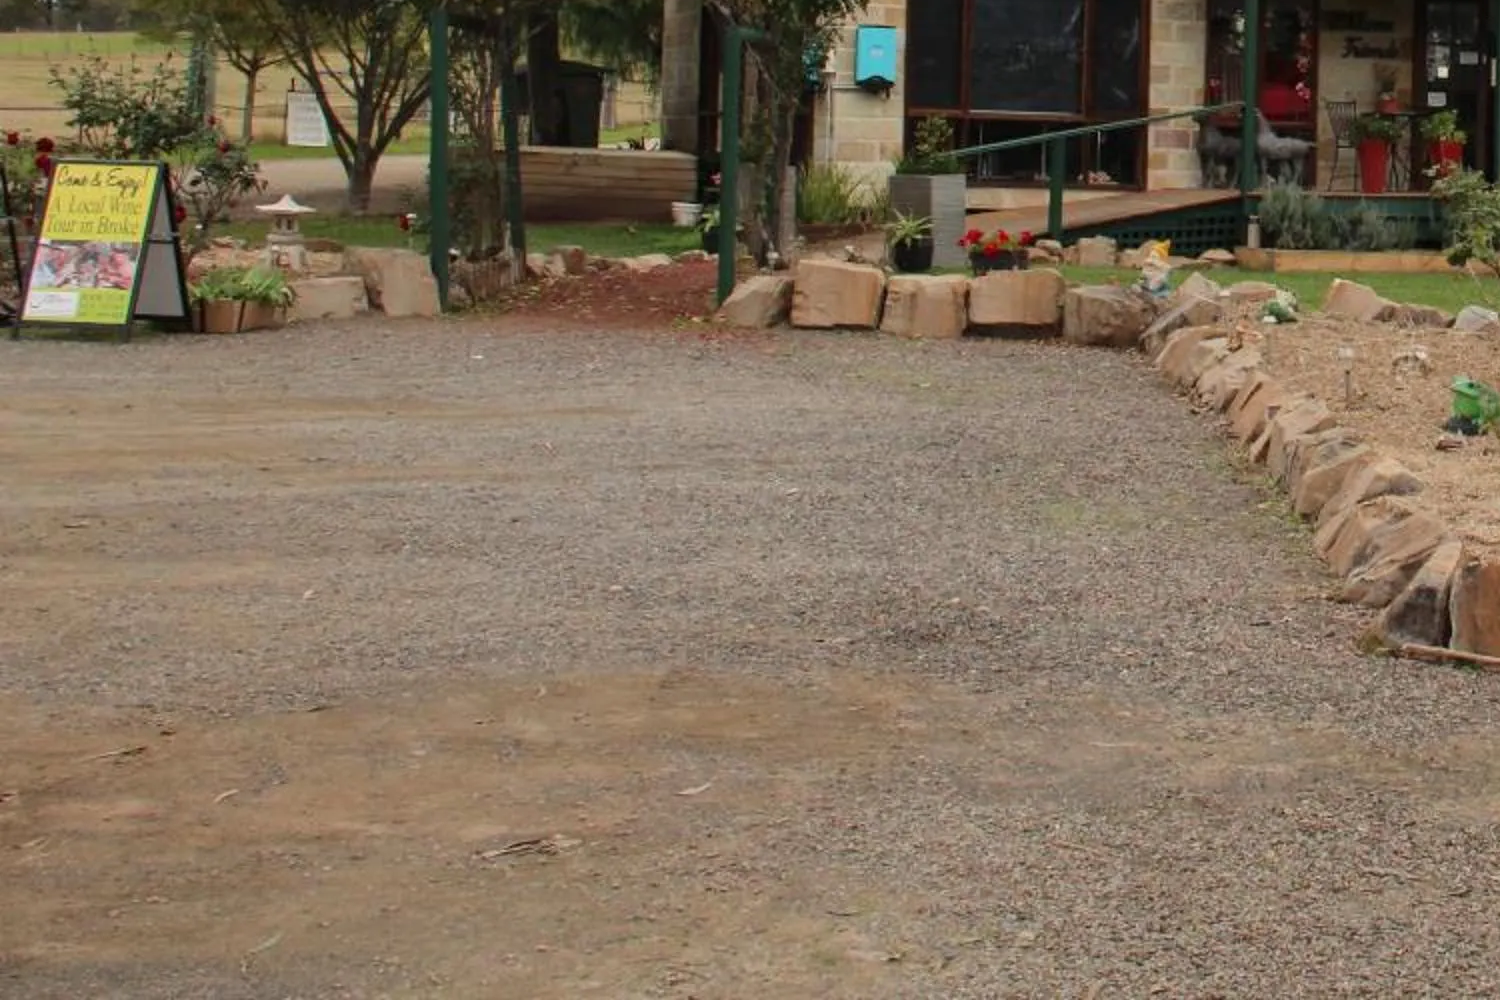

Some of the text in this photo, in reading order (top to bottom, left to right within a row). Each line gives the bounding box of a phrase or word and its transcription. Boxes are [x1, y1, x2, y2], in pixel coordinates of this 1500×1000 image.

[58, 166, 88, 186] Come
[90, 171, 101, 187] &
[49, 195, 142, 215] A Local Wine
[46, 214, 138, 235] Tour in Broke
